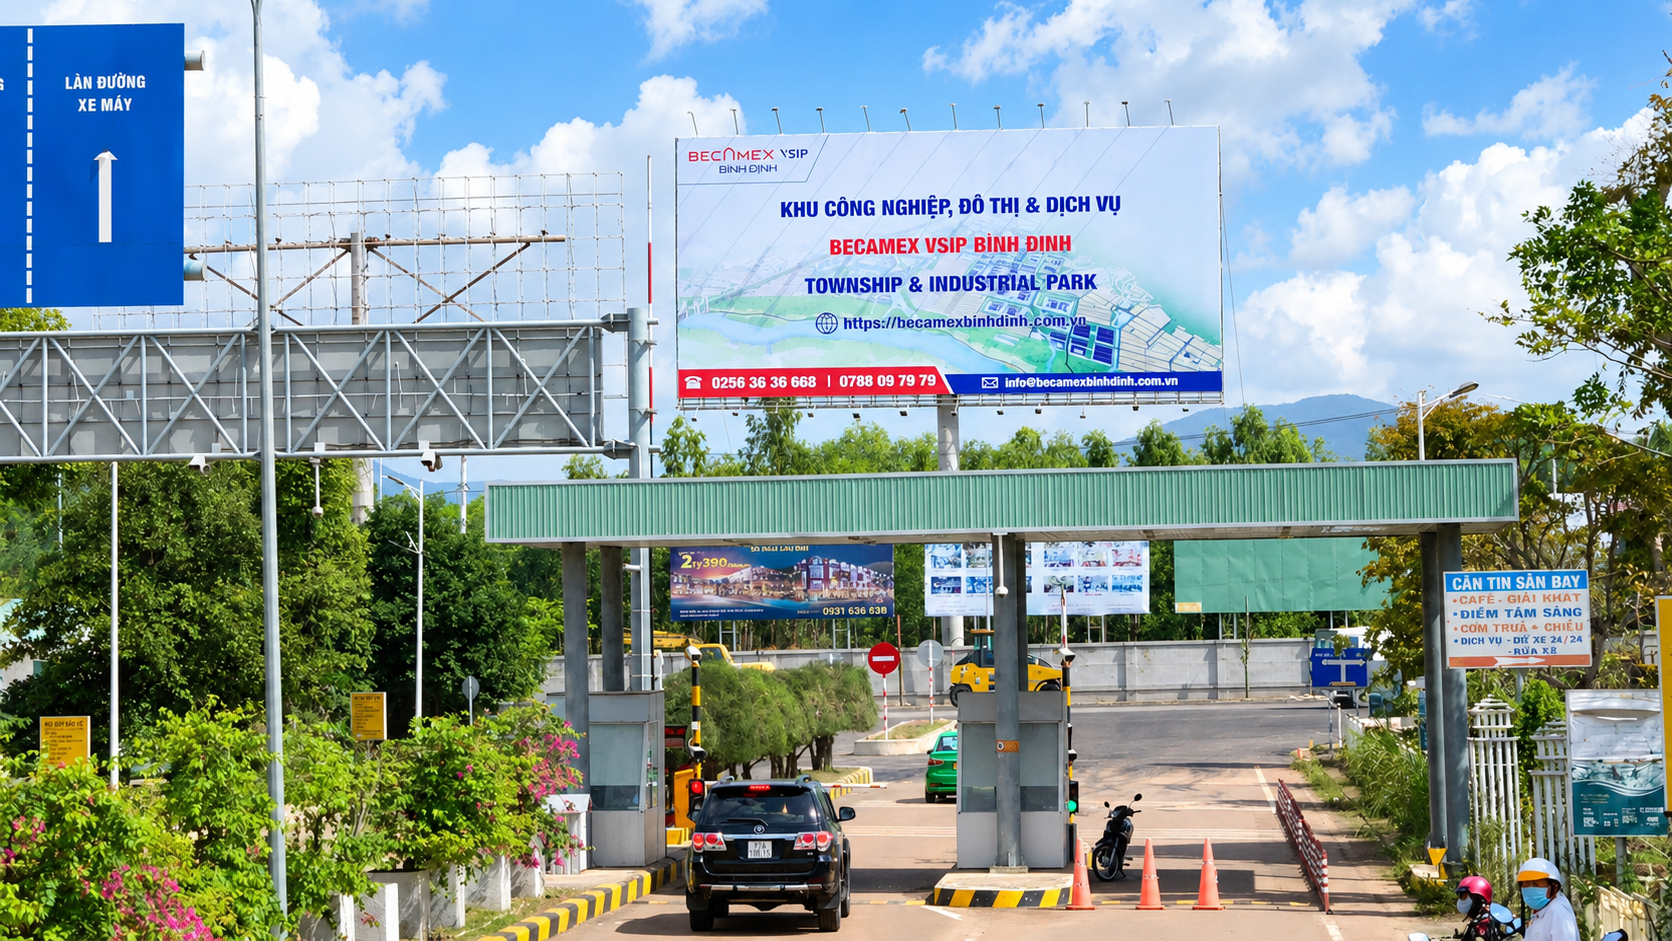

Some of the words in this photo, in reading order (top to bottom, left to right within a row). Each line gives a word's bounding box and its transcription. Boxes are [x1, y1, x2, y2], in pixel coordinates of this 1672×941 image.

[65, 73, 93, 90] LÀN
[96, 72, 146, 89] ĐƯỜNG
[78, 98, 97, 112] XE
[101, 95, 132, 112] MÁY
[688, 147, 774, 162] BECAMEX
[748, 164, 777, 175] ĐỊNH
[780, 201, 818, 217] KHU
[824, 196, 876, 217] CÔNG
[882, 194, 953, 219] NGHIỆP,
[958, 194, 984, 214] ĐÔ
[990, 197, 1019, 217] THỊ
[1025, 196, 1040, 213] &
[1046, 196, 1091, 217] DỊCH
[1096, 195, 1121, 215] VỤ
[830, 237, 919, 255] BECAMEX
[925, 236, 968, 253] VSIP
[974, 233, 1019, 253] BÌNH
[804, 276, 902, 294] TOWNSHIP
[908, 276, 923, 292] &
[929, 274, 1041, 292] INDUSTRIAL
[1046, 273, 1098, 290] PARK
[843, 314, 1087, 332] https://becamexbinhdinh.com.vn
[711, 376, 746, 389] 0256
[749, 376, 767, 388] 36
[770, 376, 788, 388] 36
[790, 375, 817, 388] 668
[839, 374, 873, 387] 0788
[877, 374, 895, 387] 09
[898, 374, 915, 386] 79
[919, 373, 936, 386] 79
[1004, 375, 1179, 389] info@becamexbinhdinh.com.vn
[1486, 576, 1512, 590] TIN
[1551, 574, 1581, 588] BAY
[822, 606, 845, 616] 0931
[848, 605, 867, 616] 636
[1488, 636, 1503, 647] VỤ
[1533, 635, 1547, 644] XE
